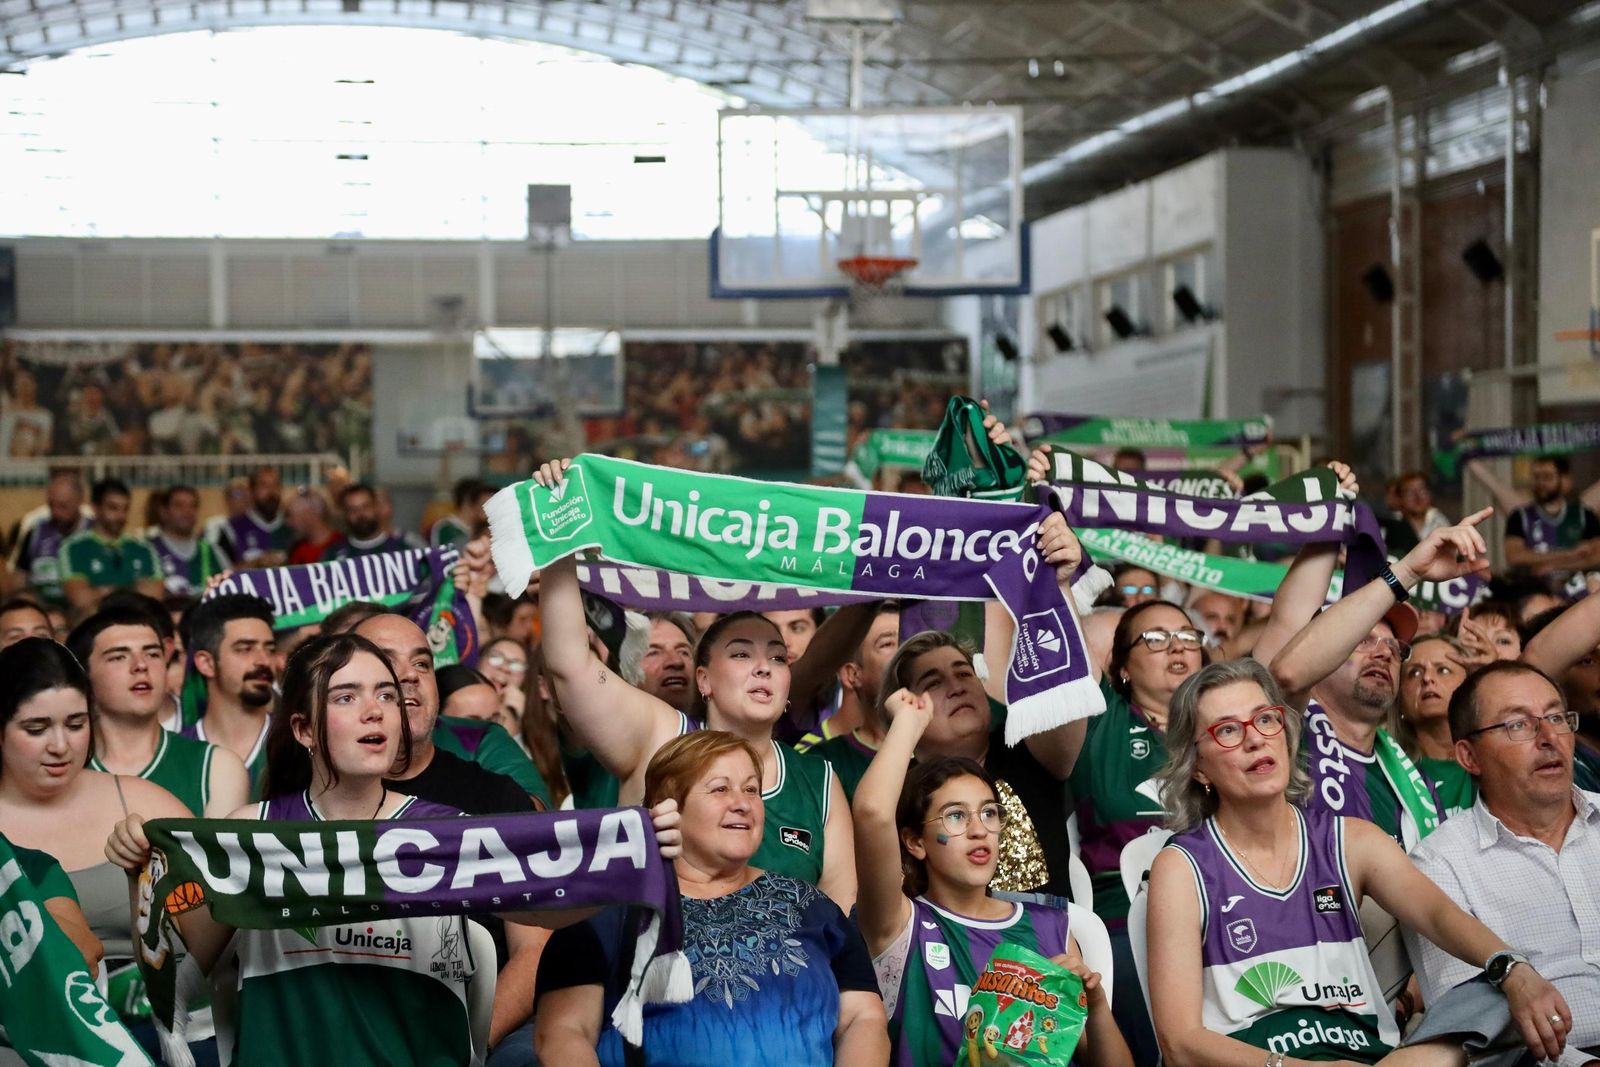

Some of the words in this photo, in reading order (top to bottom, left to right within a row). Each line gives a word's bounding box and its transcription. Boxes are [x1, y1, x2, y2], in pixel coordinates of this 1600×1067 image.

[612, 476, 799, 560] Unicaja
[812, 507, 1038, 570] Balonce
[780, 555, 925, 580] MÁLAGA
[1082, 529, 1223, 584] BALONCESTO
[307, 548, 432, 615] BALONC
[171, 808, 647, 897] UNICAJA
[281, 888, 565, 917] BALONCESTO
[335, 927, 412, 954] Unicaja
[1301, 976, 1364, 1003] Unaja
